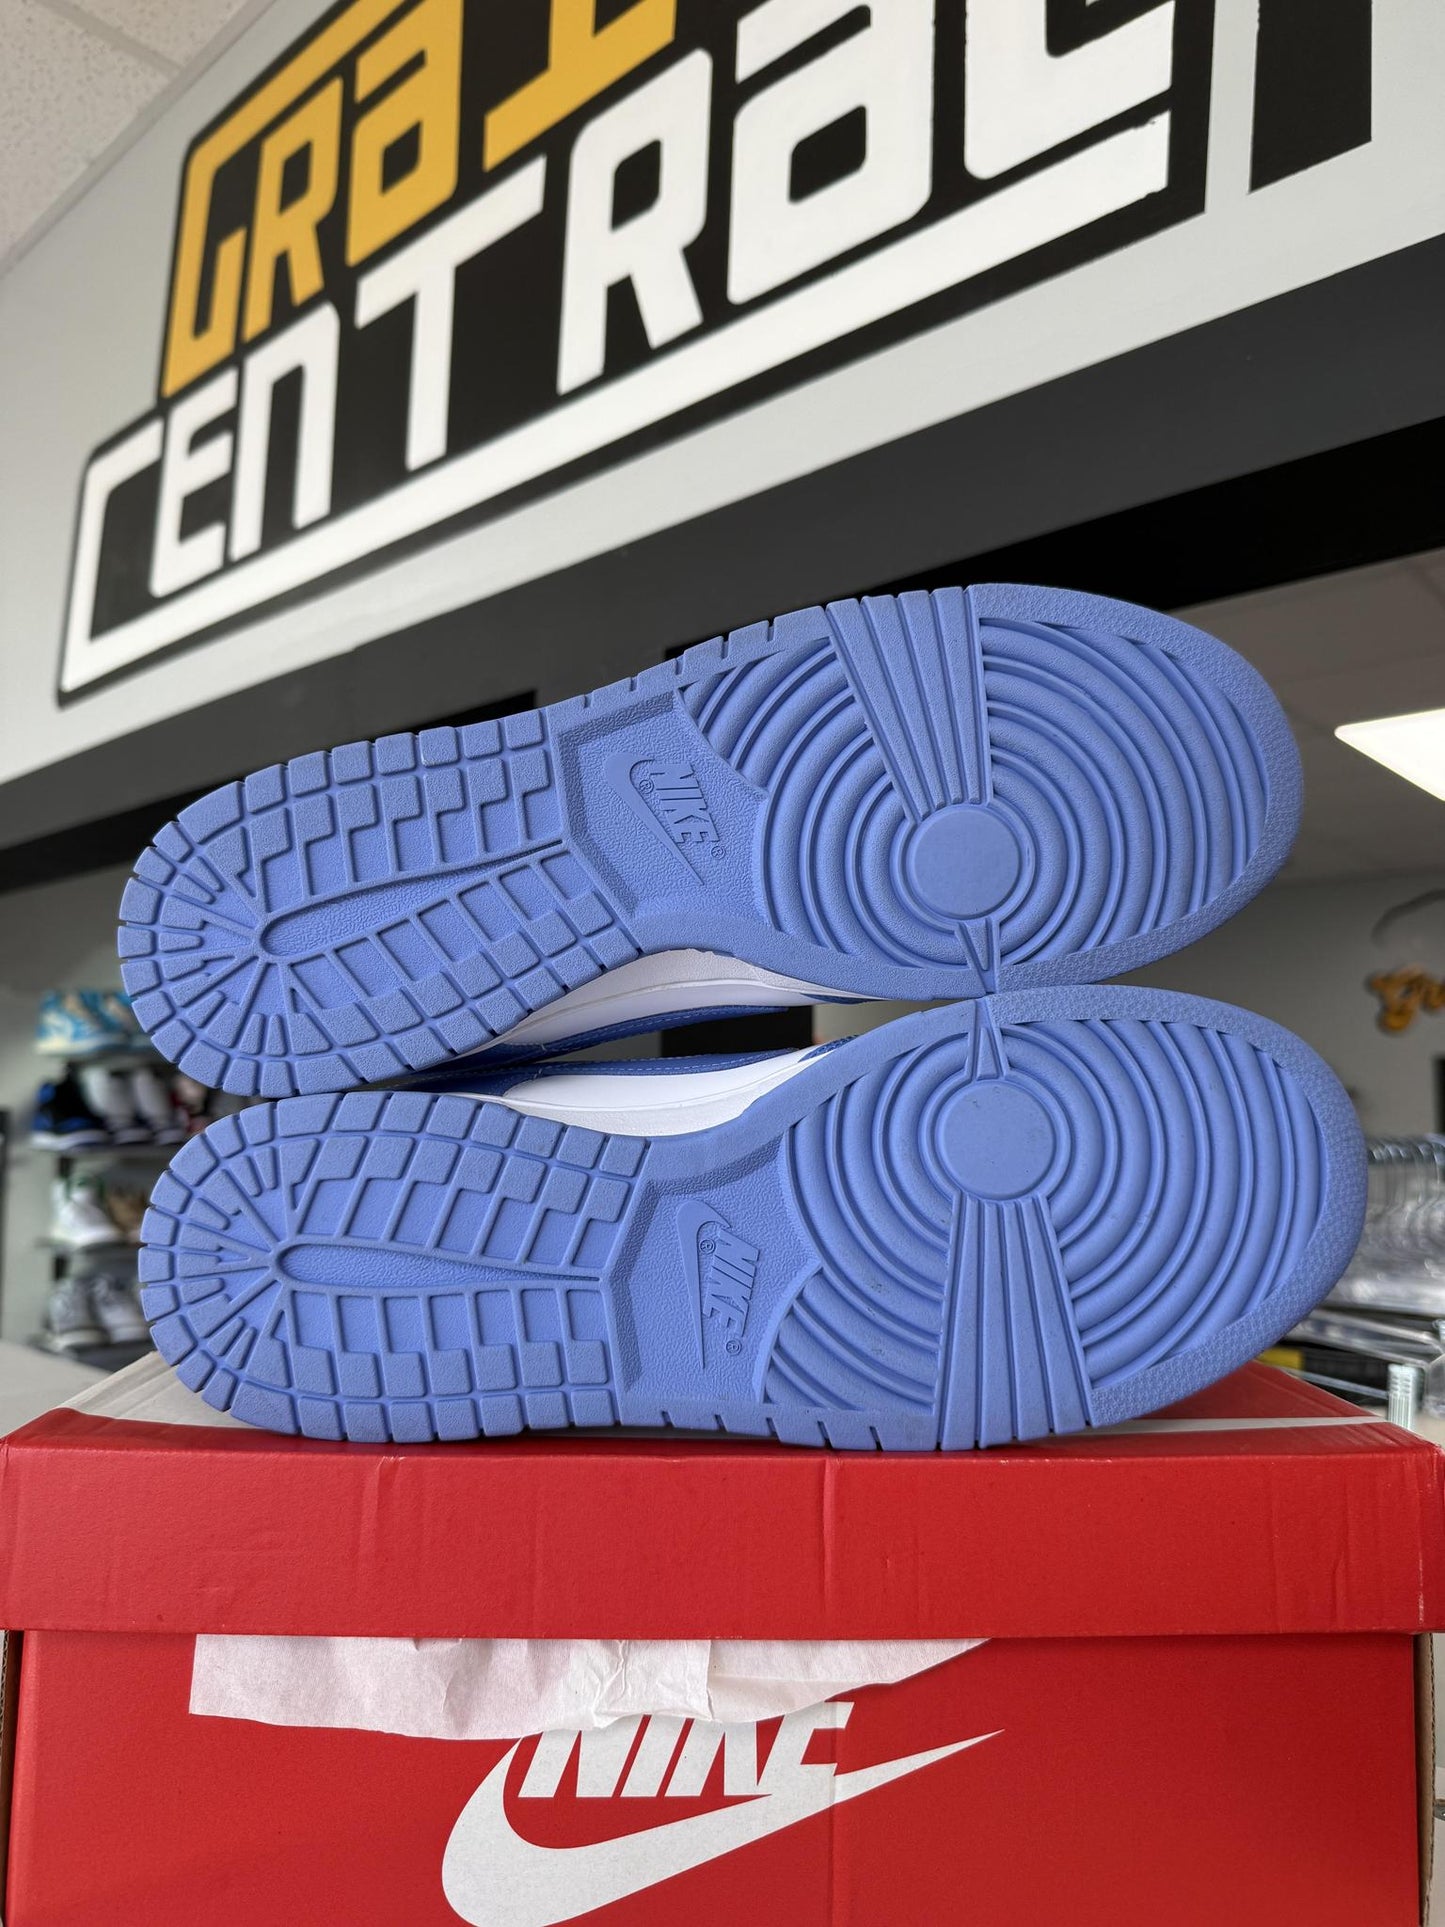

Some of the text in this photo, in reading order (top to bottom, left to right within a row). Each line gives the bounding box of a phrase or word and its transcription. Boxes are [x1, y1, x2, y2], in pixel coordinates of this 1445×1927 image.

[648, 759, 721, 845] NIKE
[701, 1227, 761, 1338] NIKE
[517, 1700, 855, 1799] NIKE
